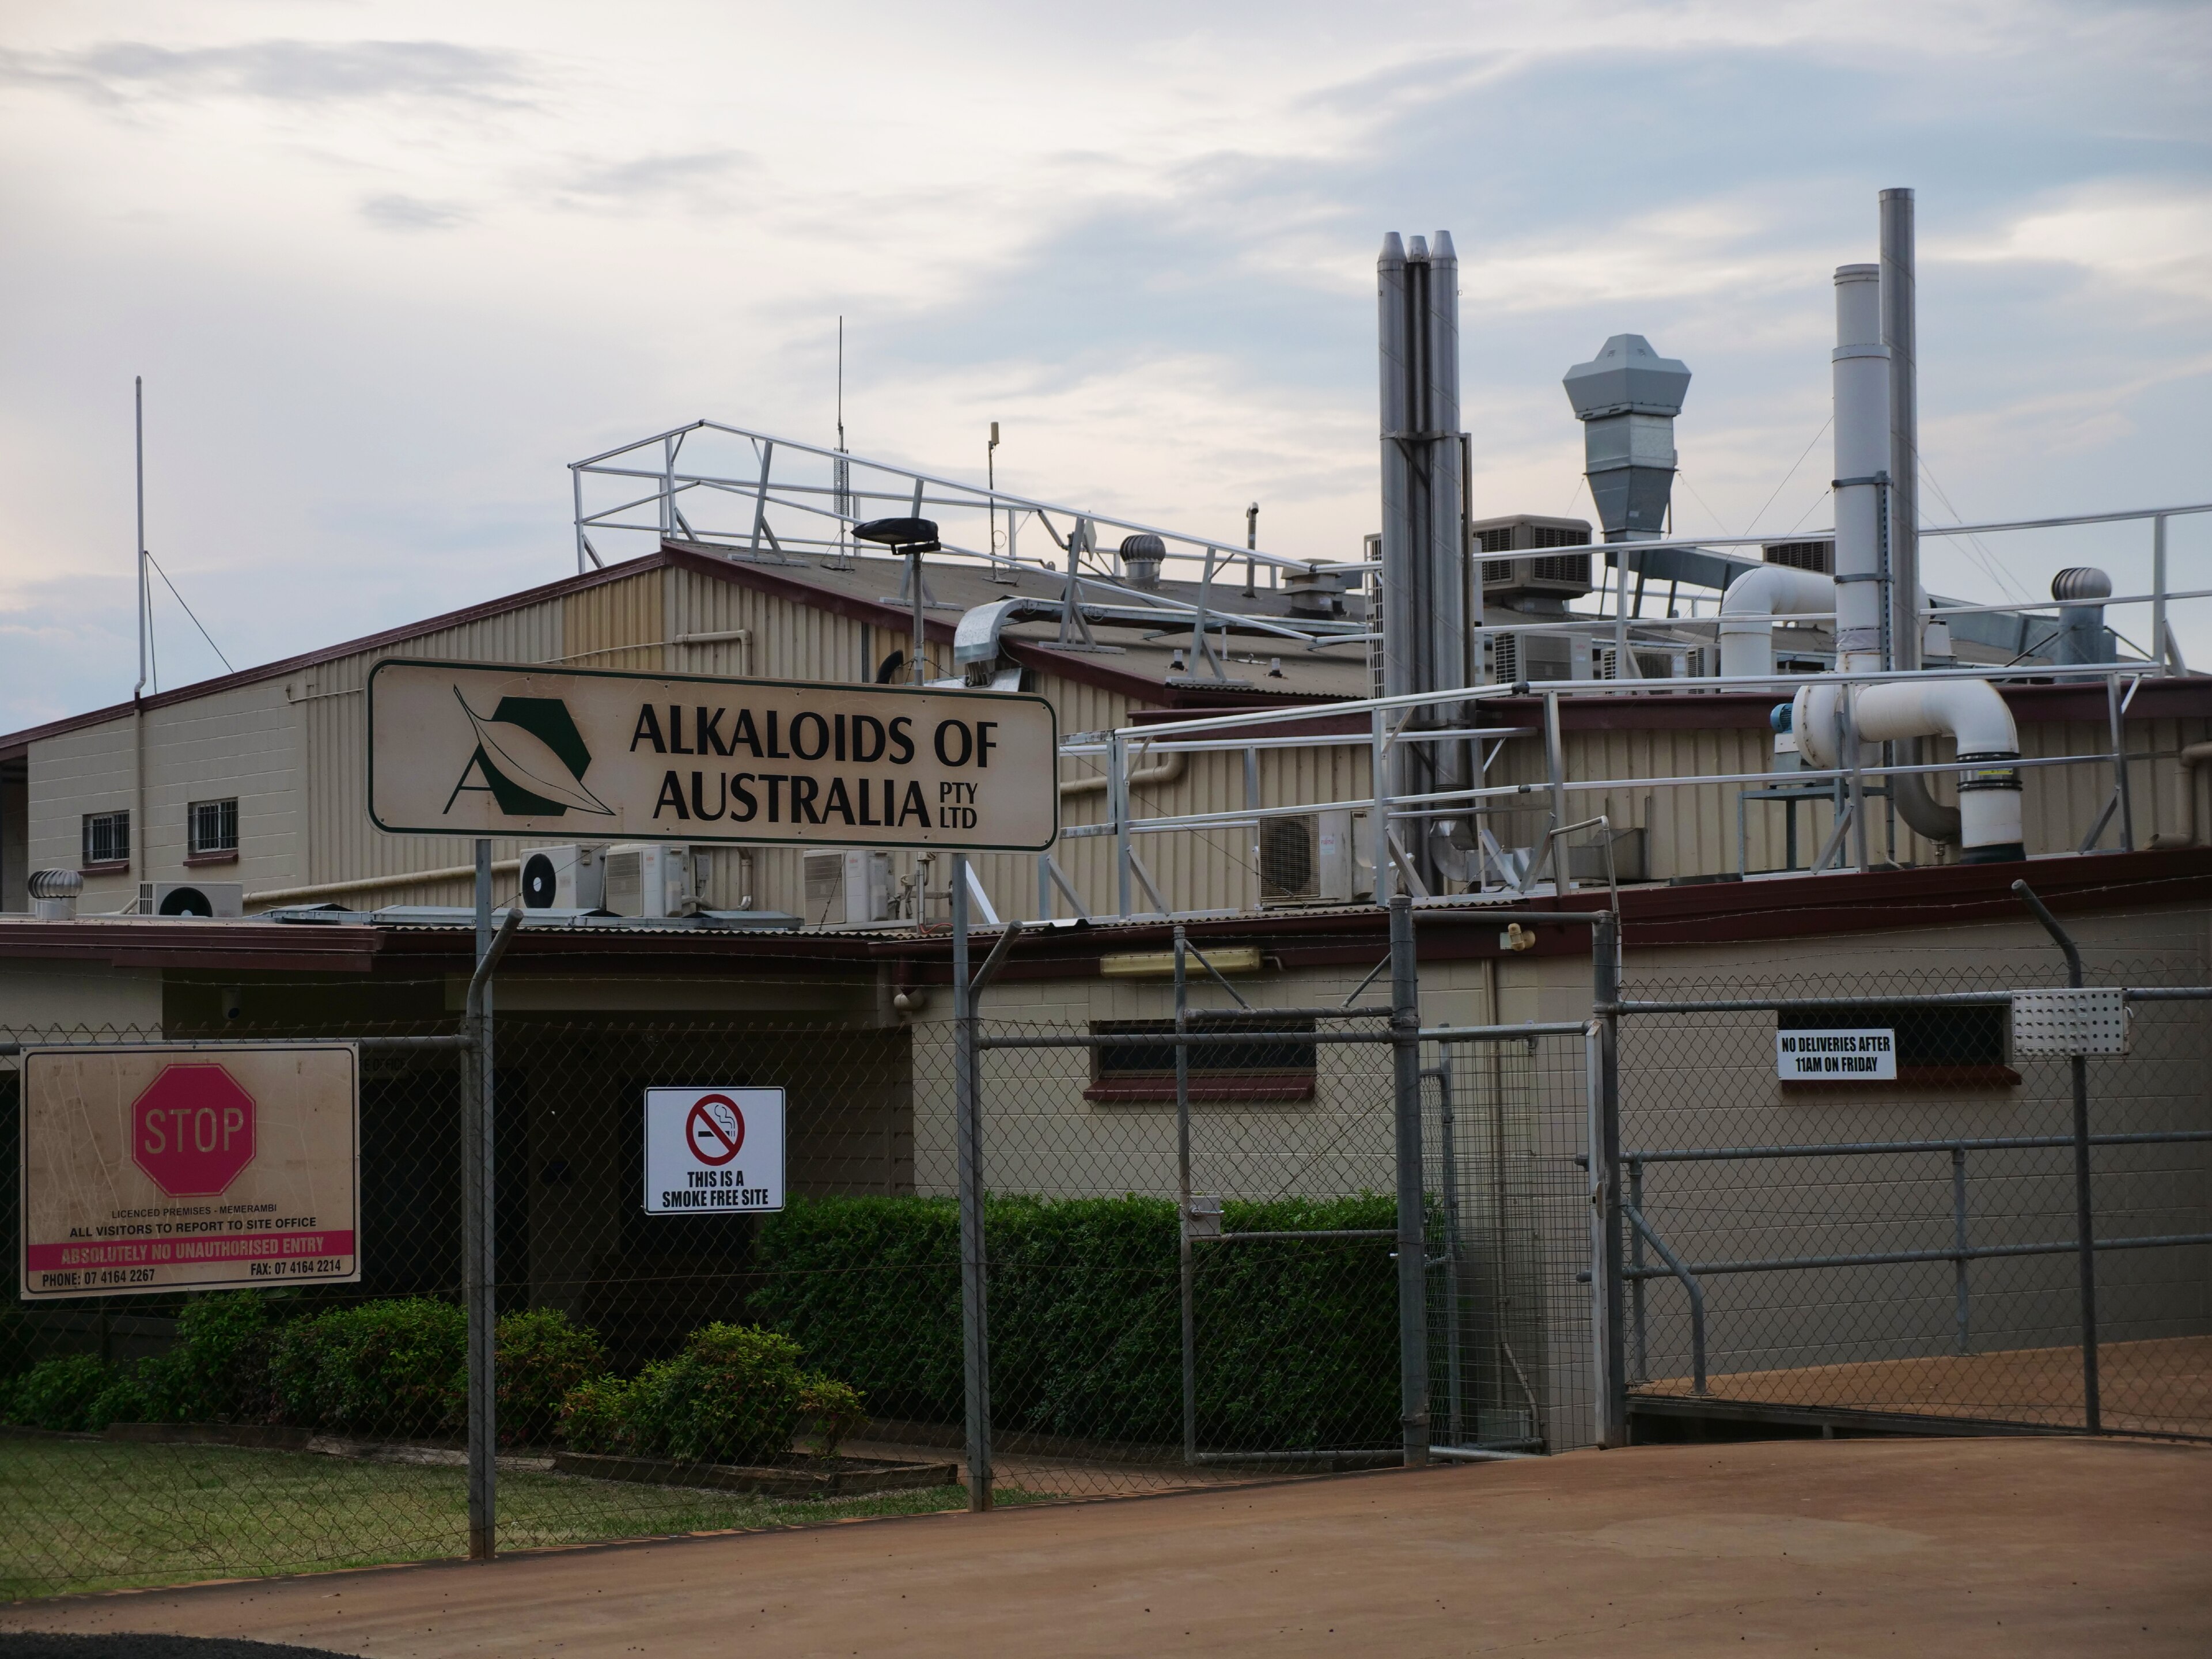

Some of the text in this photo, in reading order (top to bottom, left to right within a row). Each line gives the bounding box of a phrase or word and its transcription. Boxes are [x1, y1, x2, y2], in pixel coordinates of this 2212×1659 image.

[630, 704, 998, 767] ALKALOIDS OF
[653, 771, 932, 828] AUSTRALIA
[940, 781, 978, 804] PTY
[940, 806, 978, 829] LTD
[1782, 1036, 1891, 1052] NO DELIVERIES AFTER
[1795, 1056, 1878, 1072] 11AM ON FRIDAY
[145, 1108, 244, 1154] STOP
[687, 1171, 744, 1188] THIS IS A
[662, 1189, 768, 1208] SMOKE FREE SITE
[112, 1209, 160, 1219] LICENCED
[163, 1207, 211, 1217] PREMISES
[219, 1204, 276, 1214] MEMERAMBI
[70, 1217, 316, 1237] ALL VISITORS TO REPORT TO SITE OFFICE
[62, 1237, 324, 1265] ABSOLUTELY NO UNAUTHORISED ENTRY
[251, 1260, 340, 1275] FAX: 07 4164 2214
[43, 1269, 155, 1287] PHONE: 07 4164 2267
